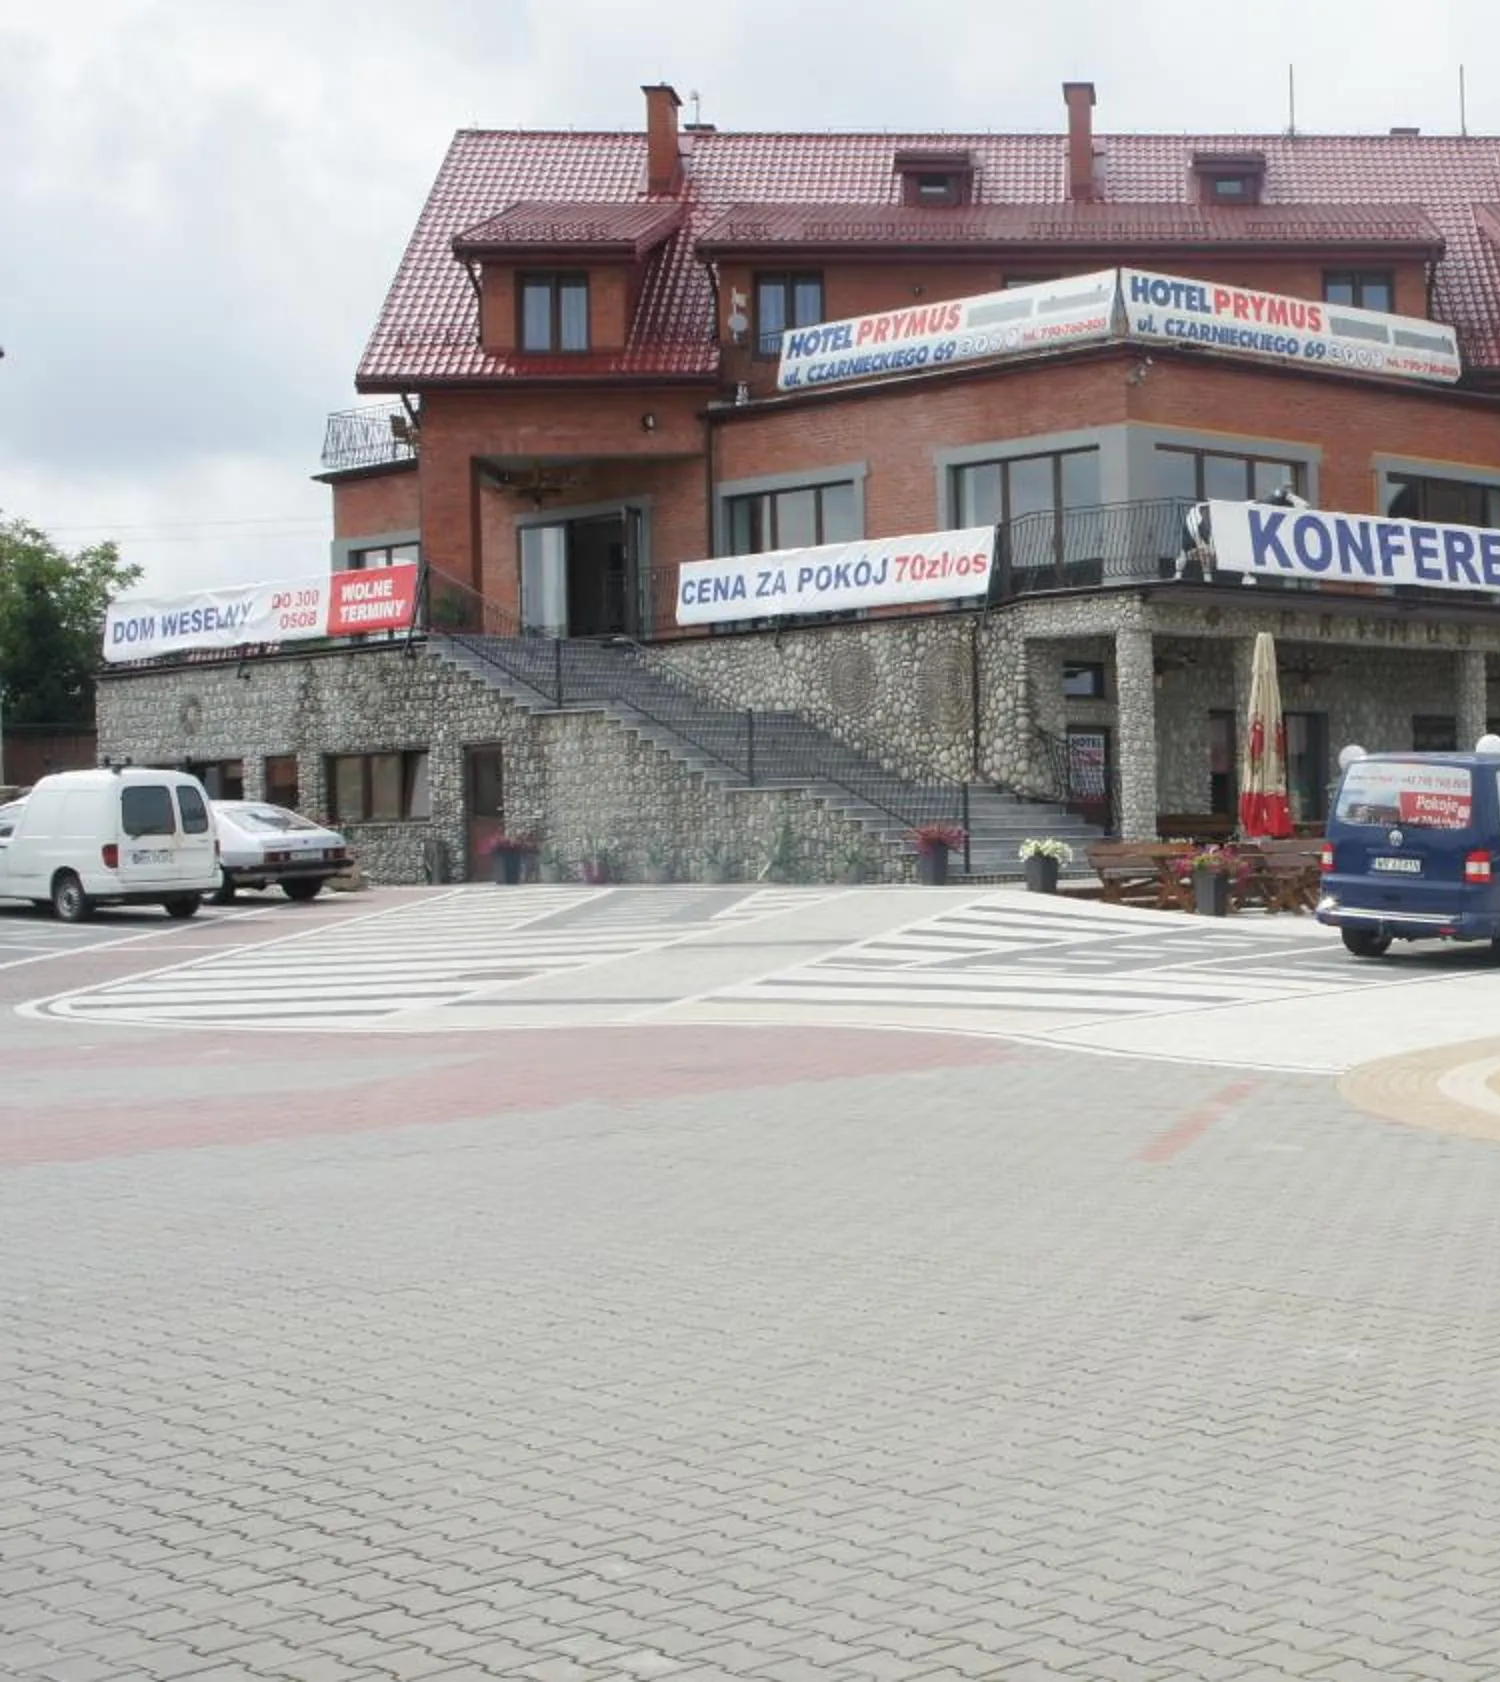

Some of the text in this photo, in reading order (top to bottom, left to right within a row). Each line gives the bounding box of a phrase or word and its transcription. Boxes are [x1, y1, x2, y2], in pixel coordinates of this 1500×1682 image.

[1131, 276, 1322, 332] HOTEL PRYMUS
[786, 303, 963, 360] HOTEL PRYMUS
[1137, 314, 1327, 359] ul. CZARNIECKIEGO 69
[784, 341, 957, 387] ul. CZARNIECKIEGO 69
[272, 592, 292, 610] DO
[341, 579, 393, 601] WOLNE
[681, 575, 748, 605] CENA
[755, 571, 787, 598] ZA
[798, 553, 888, 593] POKÓJ
[112, 601, 254, 644] DOM WESELNY
[340, 600, 406, 623] TERMINY
[1416, 795, 1459, 815] Pokoje
